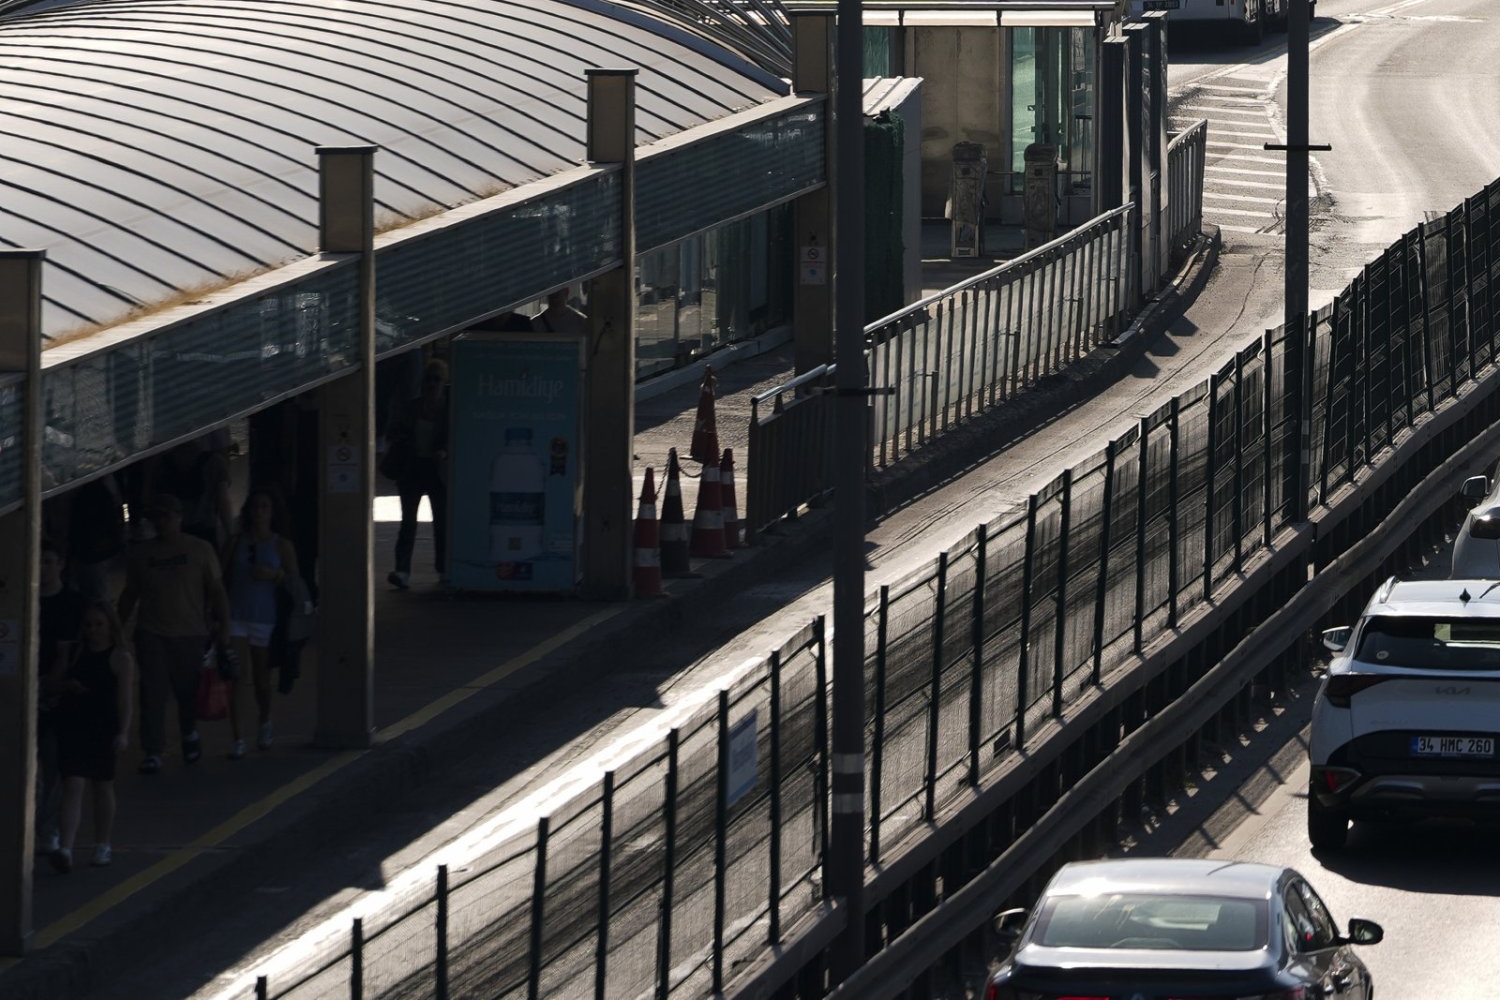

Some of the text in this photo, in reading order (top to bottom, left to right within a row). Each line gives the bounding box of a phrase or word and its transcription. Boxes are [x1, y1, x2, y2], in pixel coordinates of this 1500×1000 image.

[477, 372, 565, 404] Hamidiye
[1419, 738, 1491, 753] 34 HMC 260
